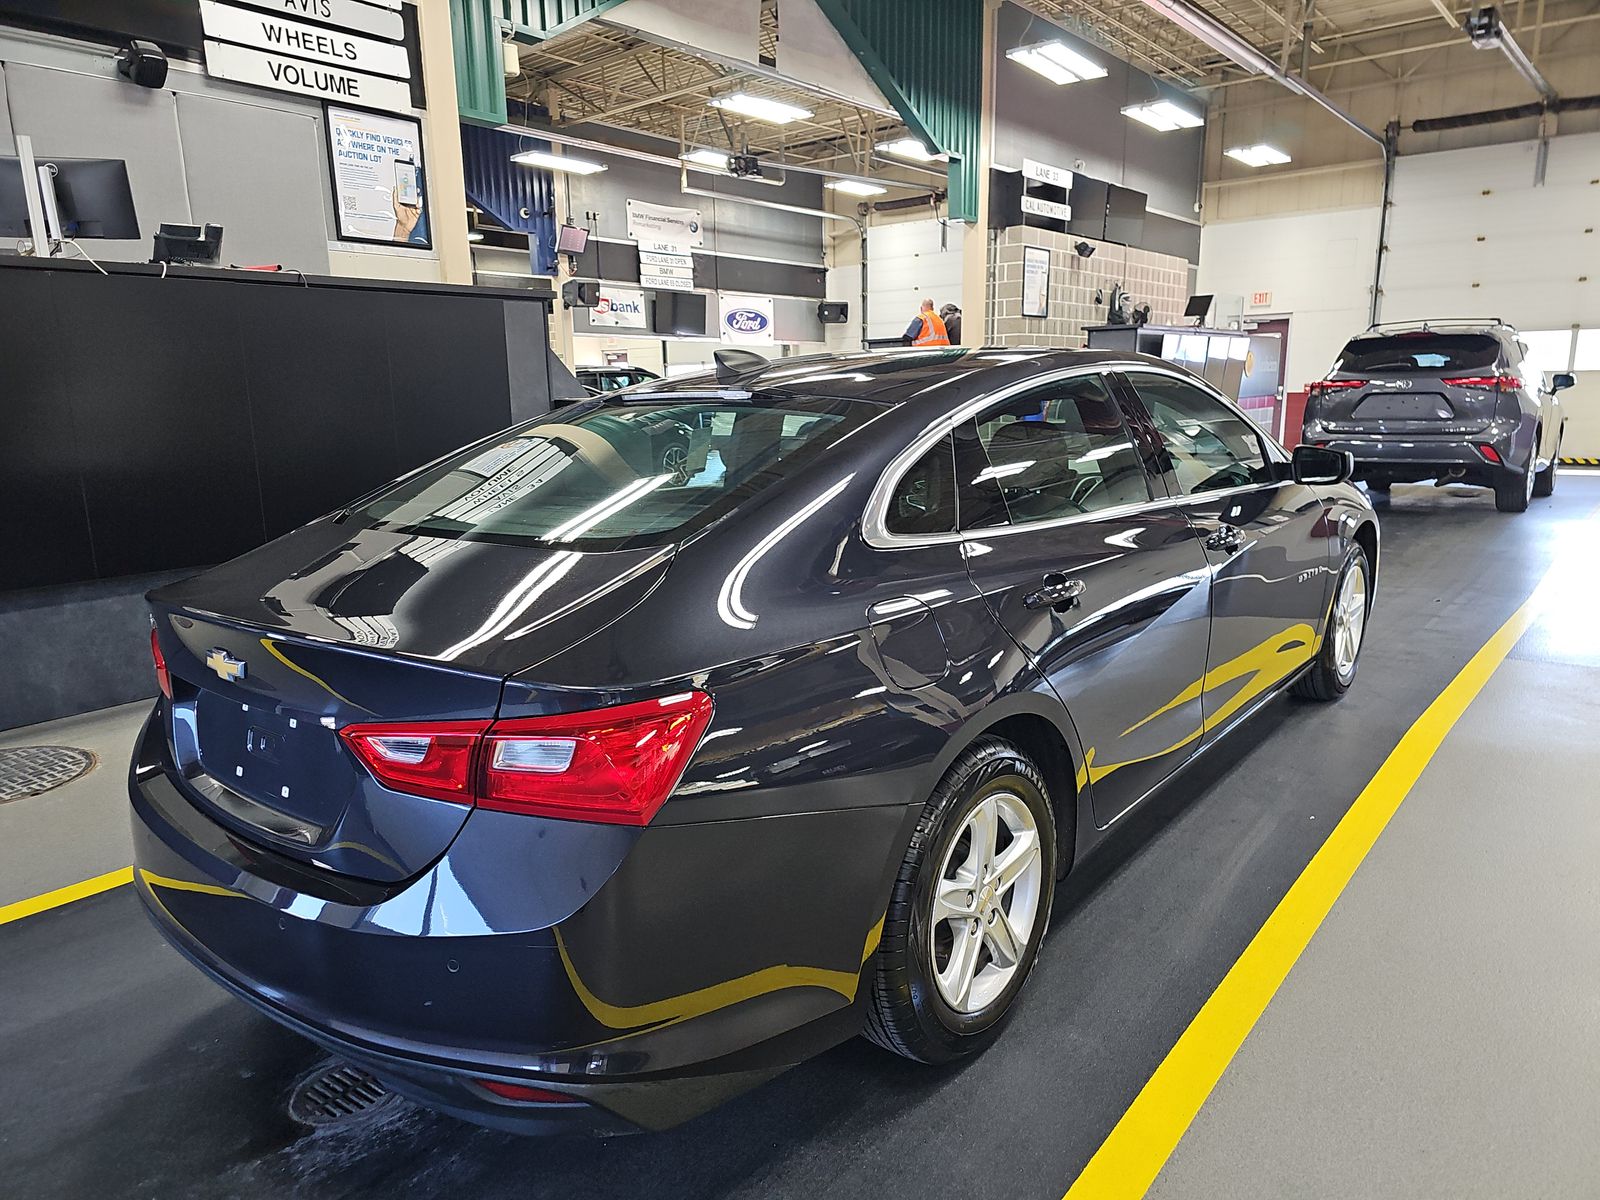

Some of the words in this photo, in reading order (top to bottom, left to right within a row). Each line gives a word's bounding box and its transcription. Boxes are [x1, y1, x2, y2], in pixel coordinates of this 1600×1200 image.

[261, 22, 357, 61] WHEELS
[267, 60, 360, 98] VOLUME
[365, 132, 381, 142] FIND
[338, 149, 368, 161] AUCTION
[369, 154, 382, 163] LOT
[376, 145, 387, 154] ON
[387, 146, 400, 156] THE
[1035, 166, 1050, 180] LANE
[1037, 201, 1067, 218] AUTOMOTIVE
[653, 243, 668, 251] LANE
[659, 267, 674, 275] BMW
[1253, 292, 1269, 305] EXIT
[732, 311, 761, 330] Ford
